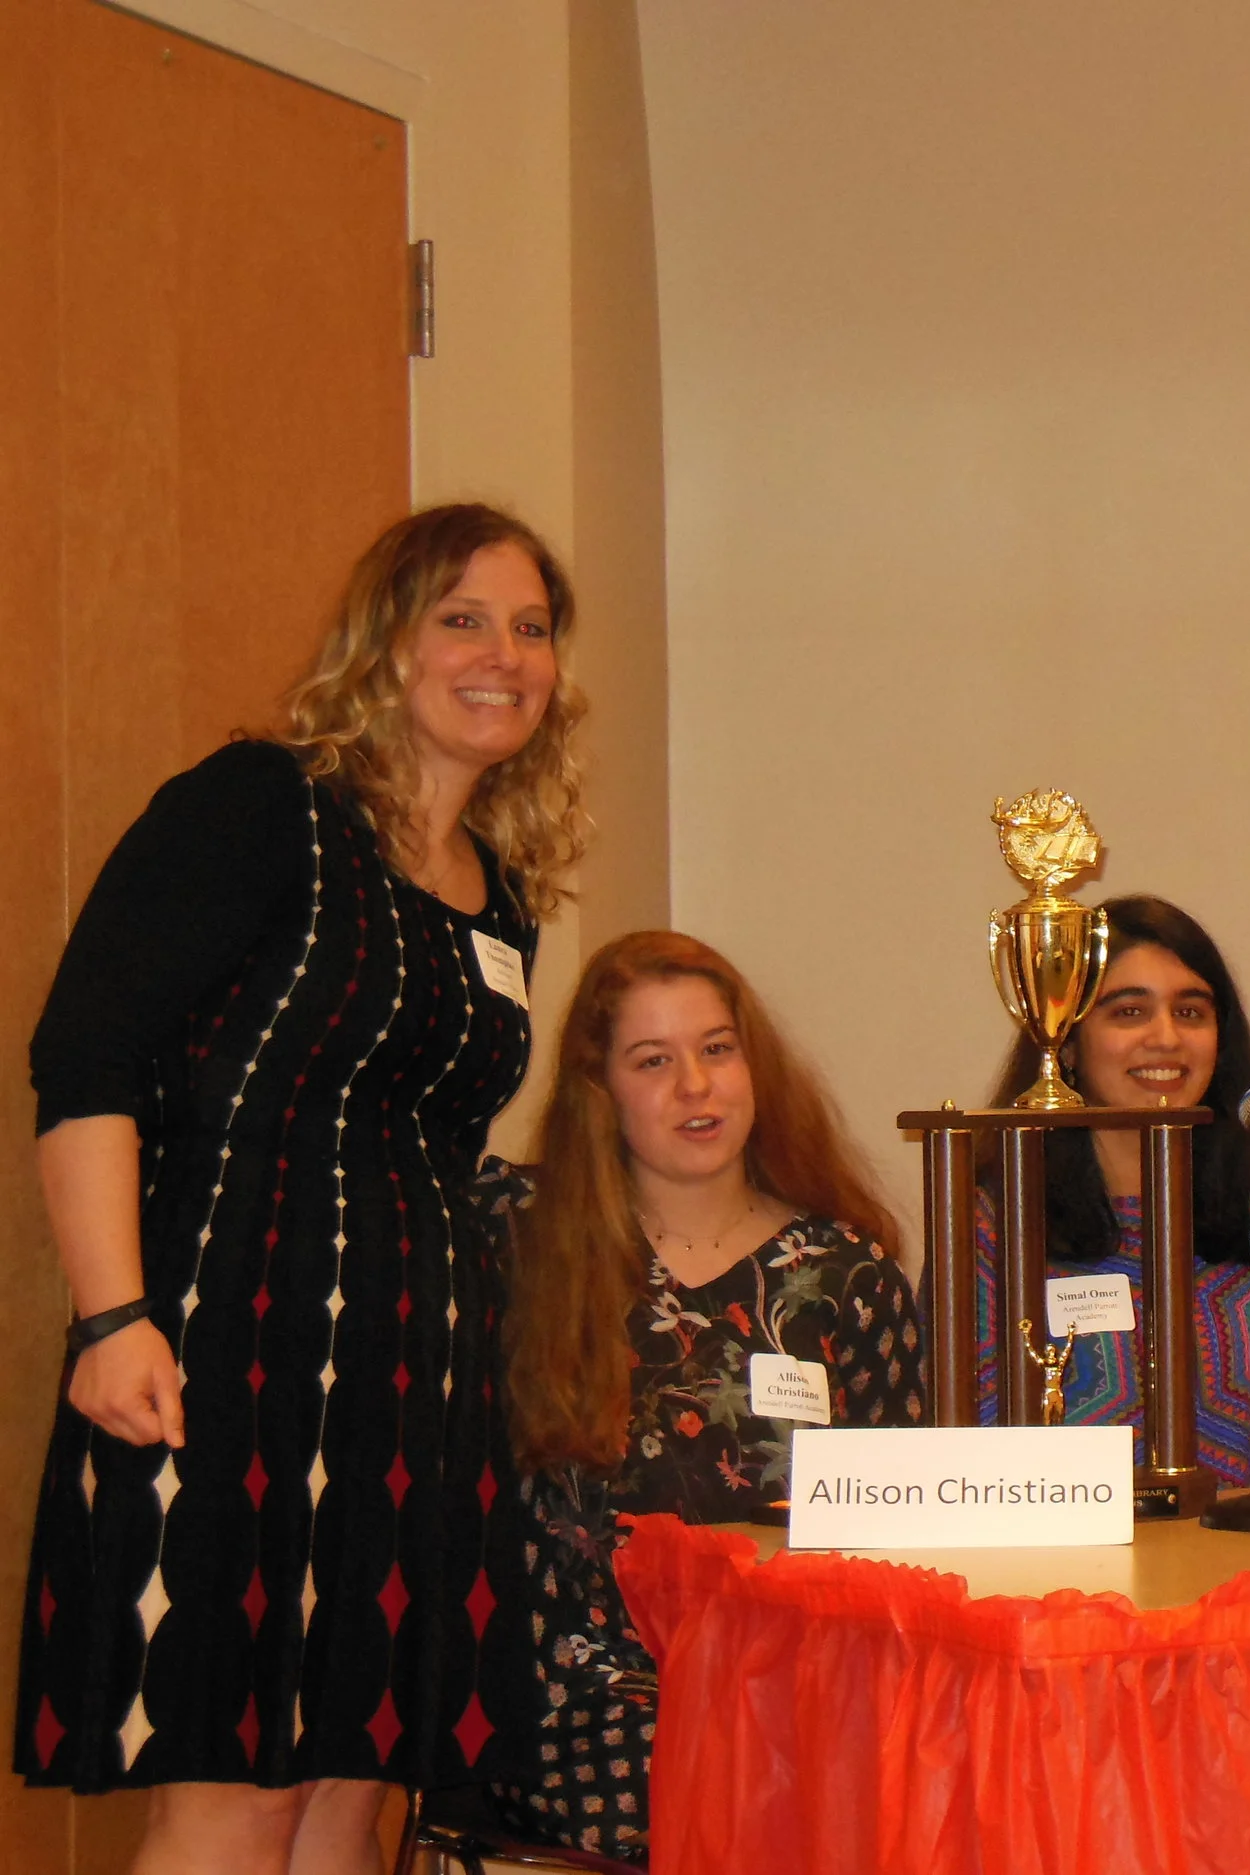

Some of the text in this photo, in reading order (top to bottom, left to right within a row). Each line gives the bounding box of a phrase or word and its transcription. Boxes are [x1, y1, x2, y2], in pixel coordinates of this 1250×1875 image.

[1056, 1288, 1119, 1302] Simal Omer
[767, 1385, 819, 1400] Christiano
[809, 1477, 1113, 1505] Allison Christiano
